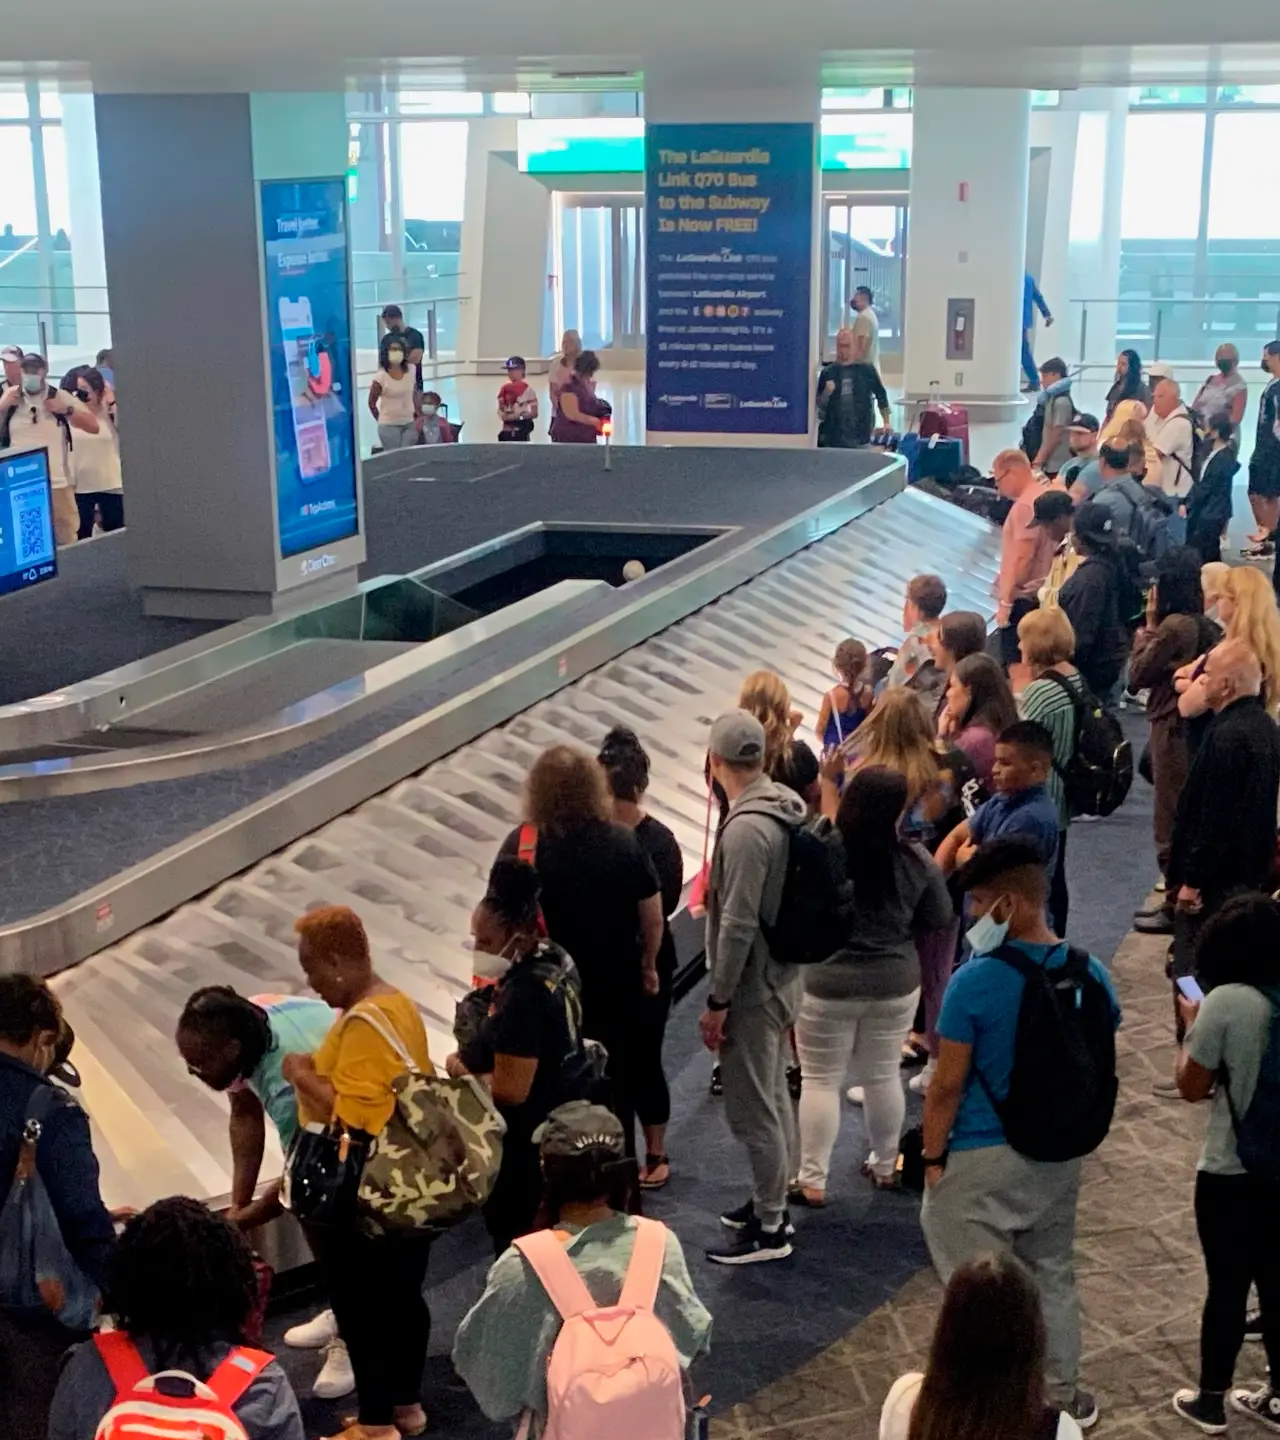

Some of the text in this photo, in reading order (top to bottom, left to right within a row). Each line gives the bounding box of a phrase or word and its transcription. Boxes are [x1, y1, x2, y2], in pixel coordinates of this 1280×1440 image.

[658, 148, 770, 164] The LaGuardia
[658, 172, 757, 189] Link Q70 Bus
[658, 194, 770, 213] to the Subway
[658, 218, 758, 232] Is Now FREE!
